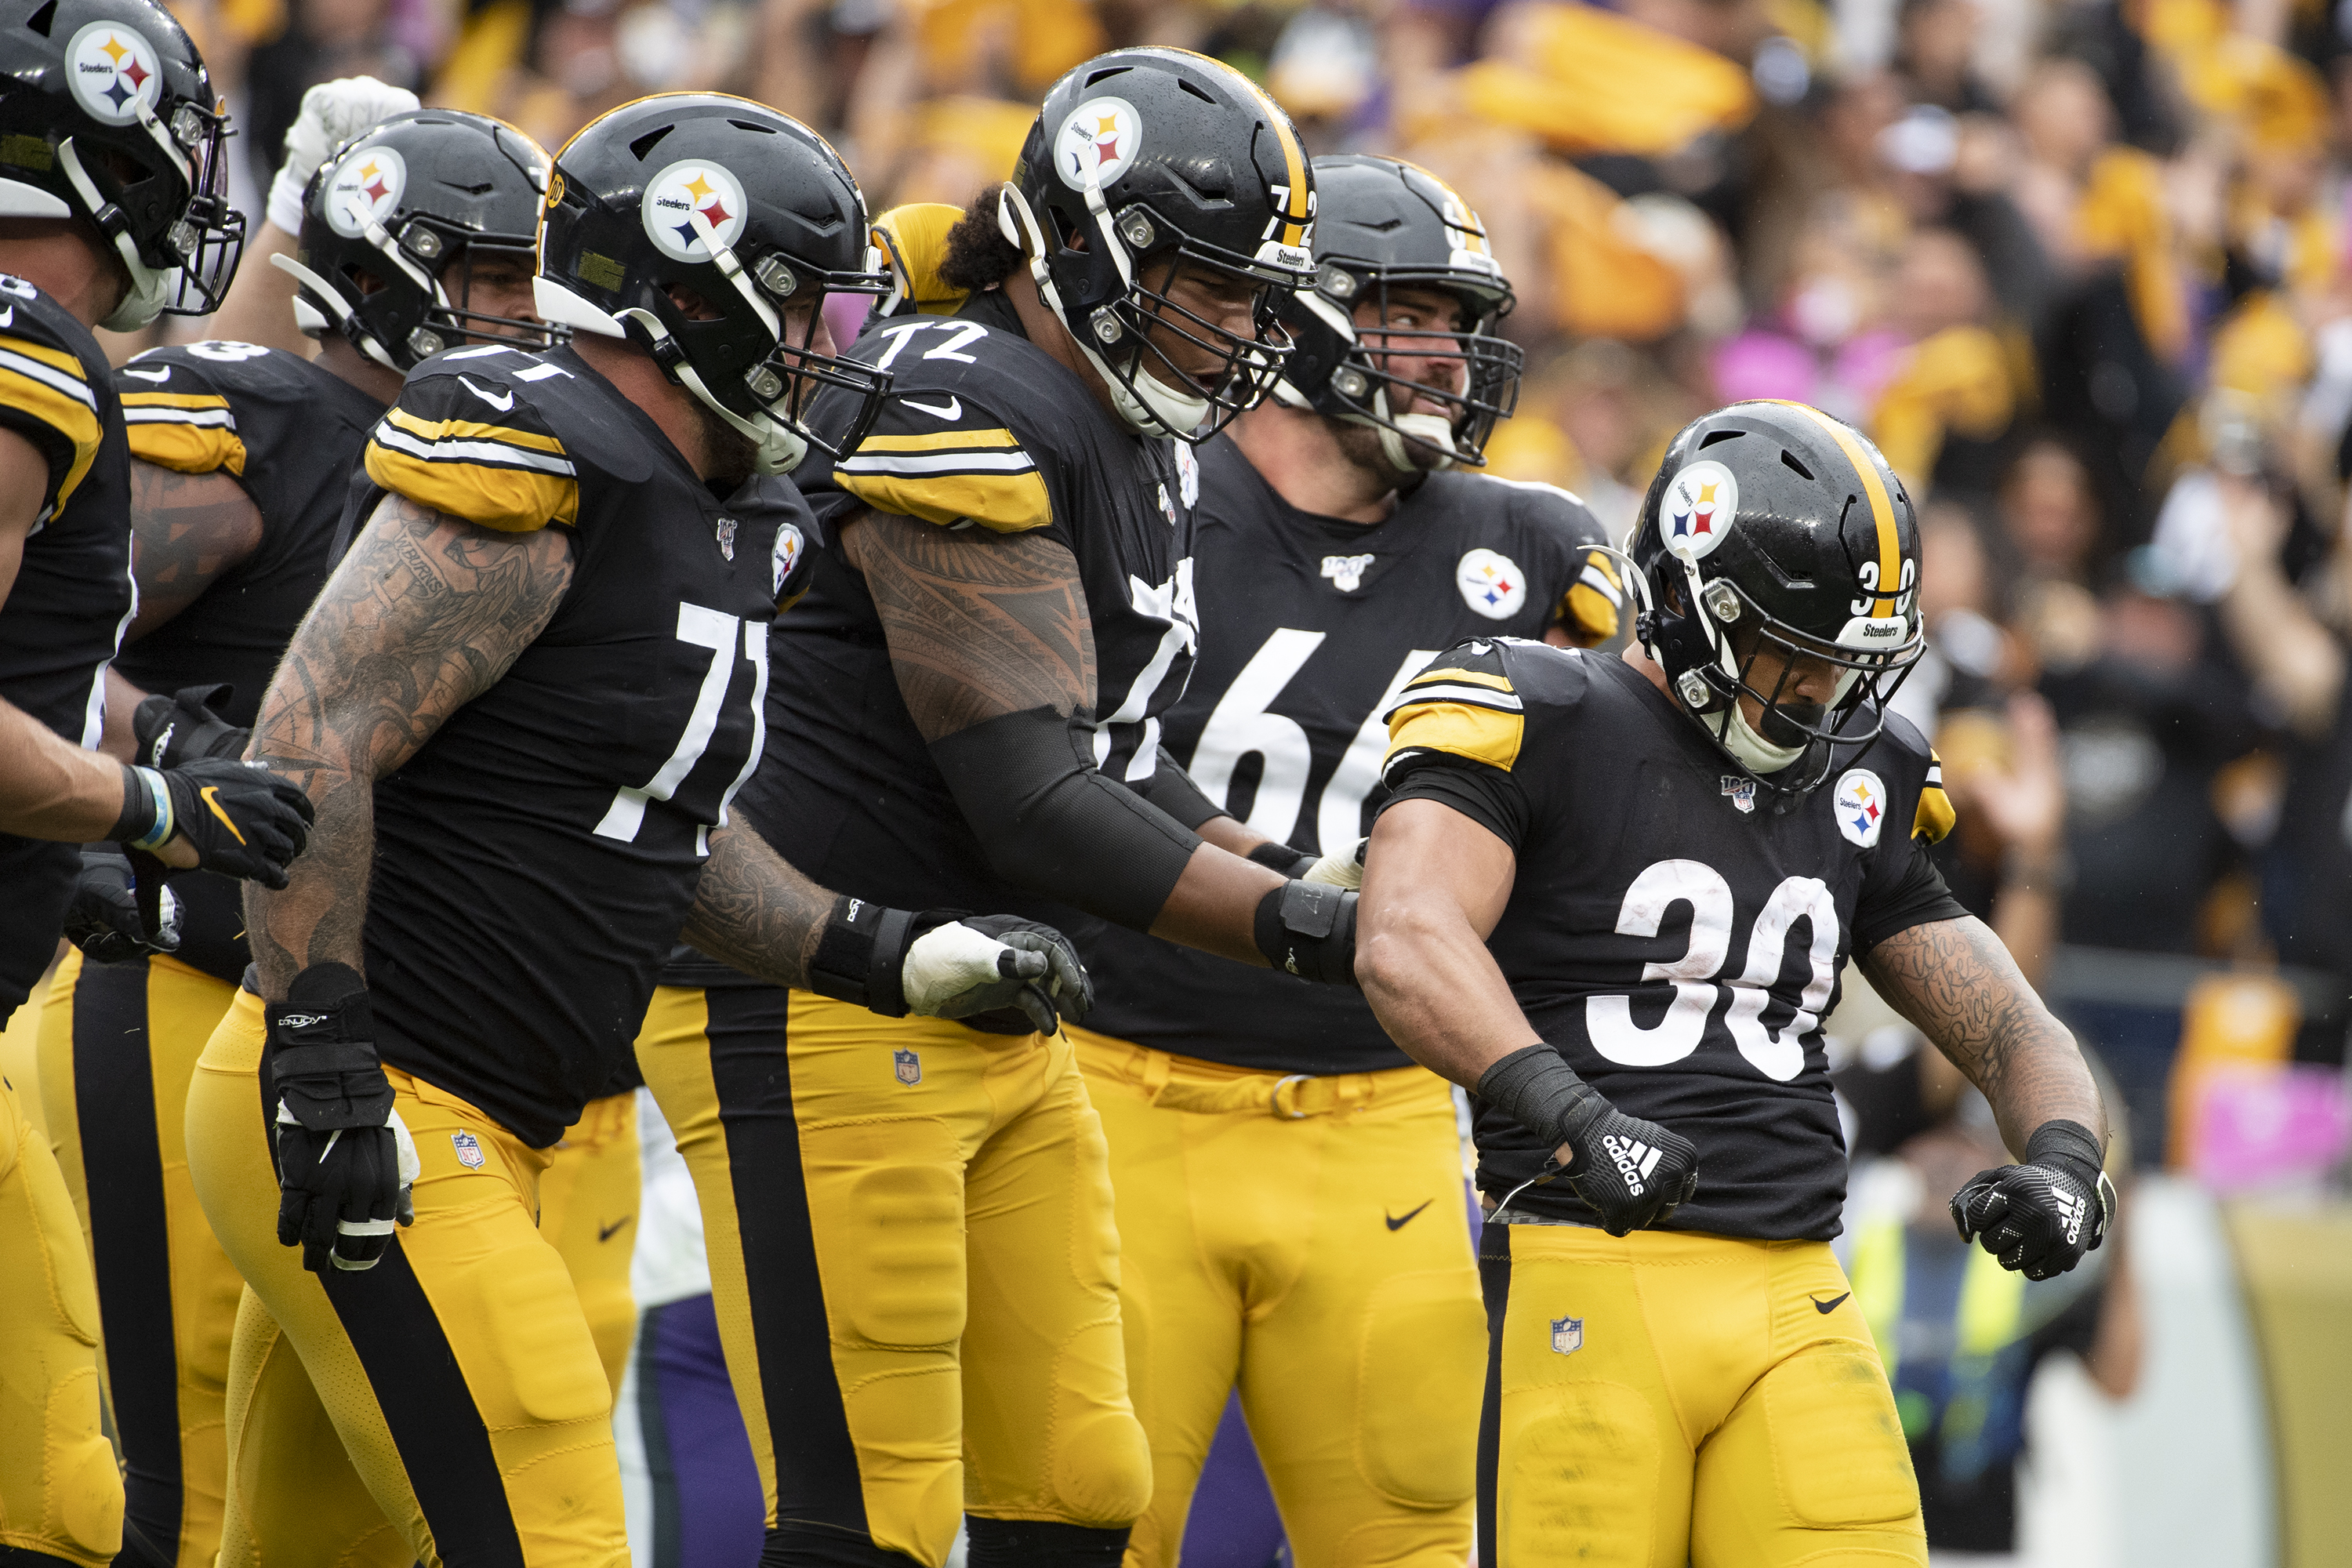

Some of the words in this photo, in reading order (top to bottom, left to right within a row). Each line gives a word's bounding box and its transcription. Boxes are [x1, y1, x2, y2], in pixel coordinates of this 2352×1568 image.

[80, 62, 113, 74] Steelers
[1070, 121, 1093, 142] Steelers
[656, 195, 691, 212] Steelers
[1261, 184, 1318, 248] 72
[1276, 248, 1305, 267] Steelers
[877, 320, 989, 370] 72
[1678, 481, 1693, 507] Steelers
[1850, 557, 1915, 616] 30
[1863, 622, 1899, 637] Steelers
[592, 601, 770, 858] 71
[1839, 797, 1862, 811] Steelers
[1585, 858, 1840, 1082] 30
[1602, 1134, 1644, 1196] adidas
[2067, 1195, 2086, 1245] adidas
